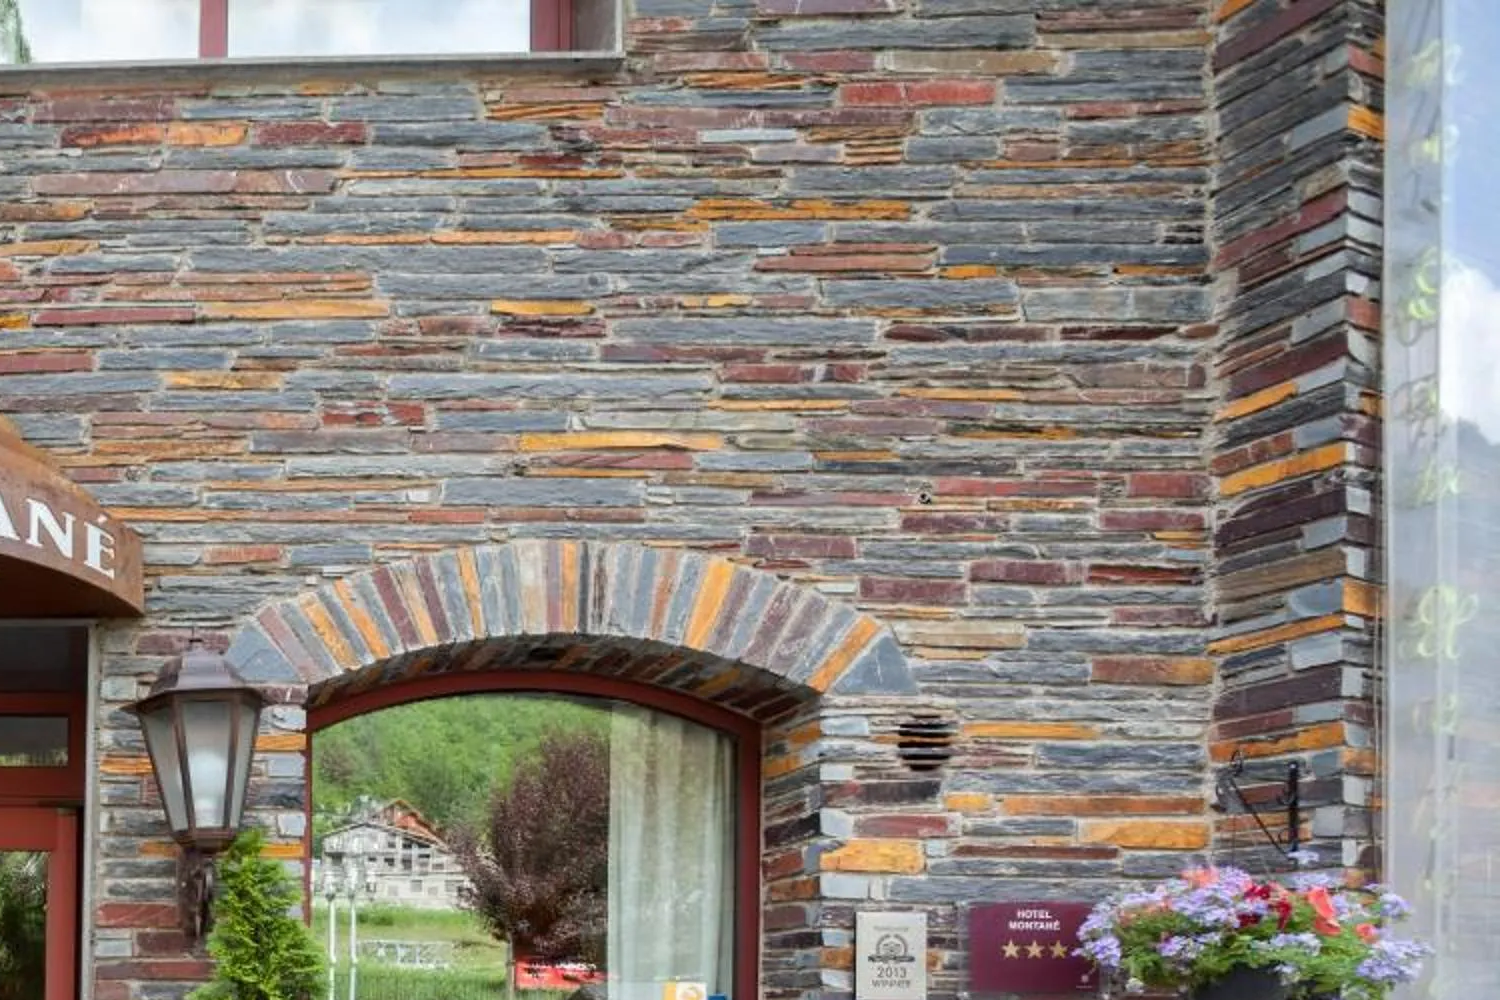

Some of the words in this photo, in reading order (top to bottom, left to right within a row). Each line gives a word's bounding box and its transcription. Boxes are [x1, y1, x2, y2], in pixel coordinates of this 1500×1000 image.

[1016, 909, 1052, 919] HOTEL
[1008, 920, 1061, 931] MONTANÉ
[876, 966, 908, 979] 2013
